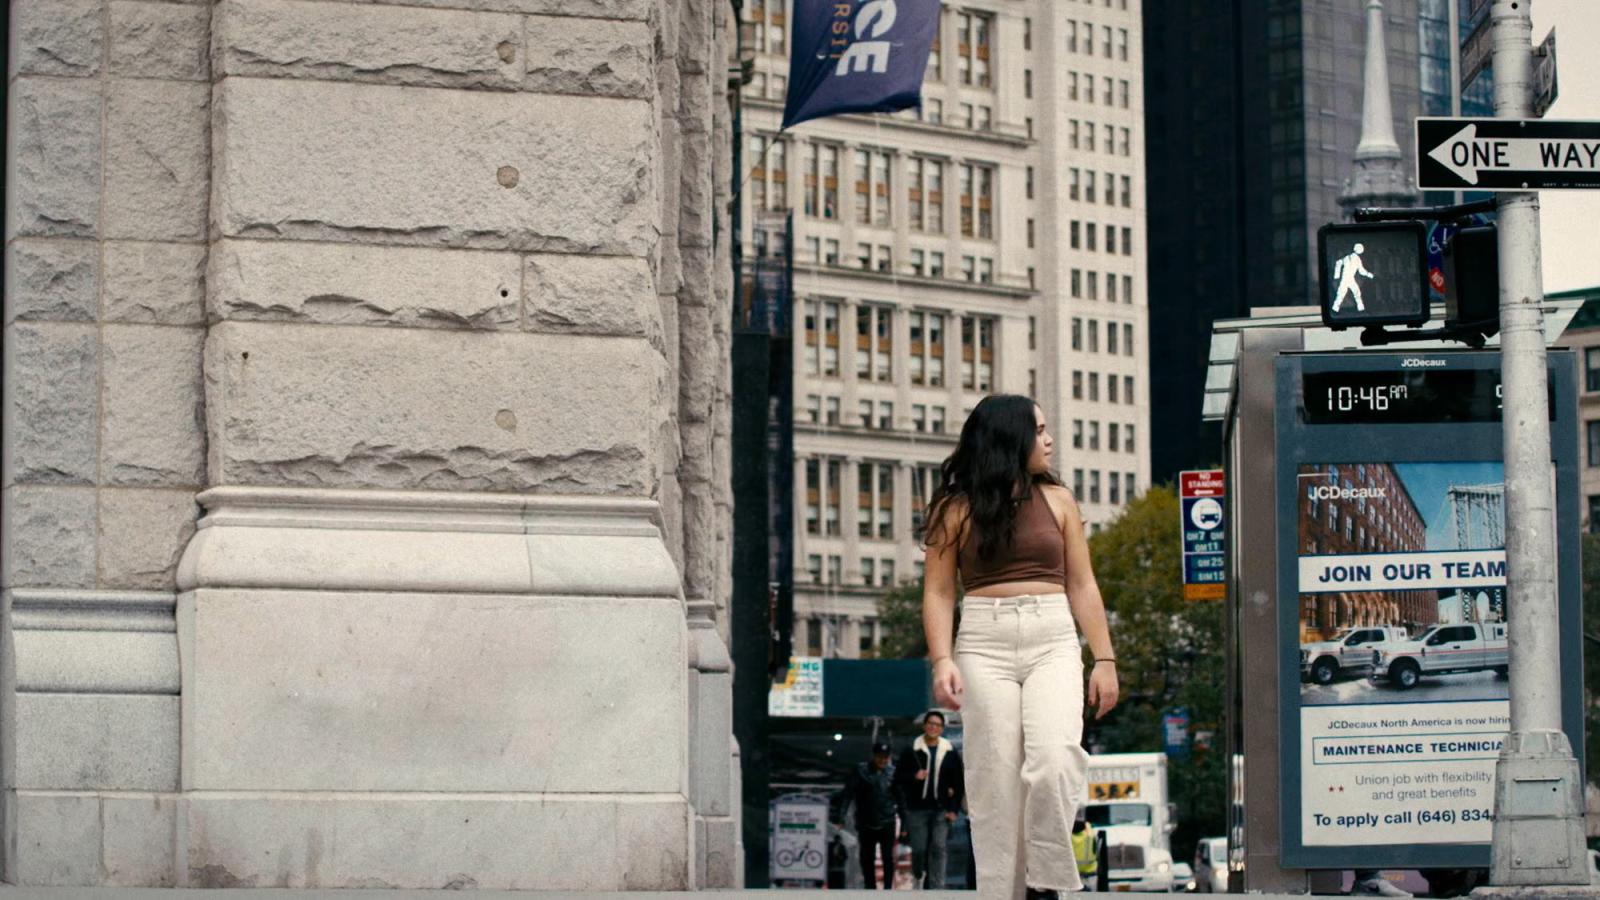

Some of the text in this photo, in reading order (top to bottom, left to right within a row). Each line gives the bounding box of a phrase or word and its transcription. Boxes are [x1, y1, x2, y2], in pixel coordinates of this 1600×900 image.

[1451, 141, 1600, 168] ONE WAY
[1401, 358, 1447, 367] JCDecaux
[1328, 385, 1408, 411] 10:46 AM
[1199, 472, 1211, 480] NO
[1188, 480, 1223, 489] STANDING
[1308, 486, 1387, 500] JCDecaux
[1318, 561, 1506, 583] JOIN OUR TEAM
[1328, 719, 1378, 729] JCDecaux
[1381, 719, 1409, 728] North
[1411, 717, 1452, 727] America
[1454, 716, 1463, 726] is
[1323, 743, 1424, 756] MAINTENANCE
[1355, 770, 1493, 787] Union job with flexibility
[1371, 787, 1477, 801] and great benefits
[1313, 813, 1331, 826] To
[1336, 812, 1379, 828] apply
[1384, 811, 1412, 823] call
[1417, 810, 1456, 825] (646)
